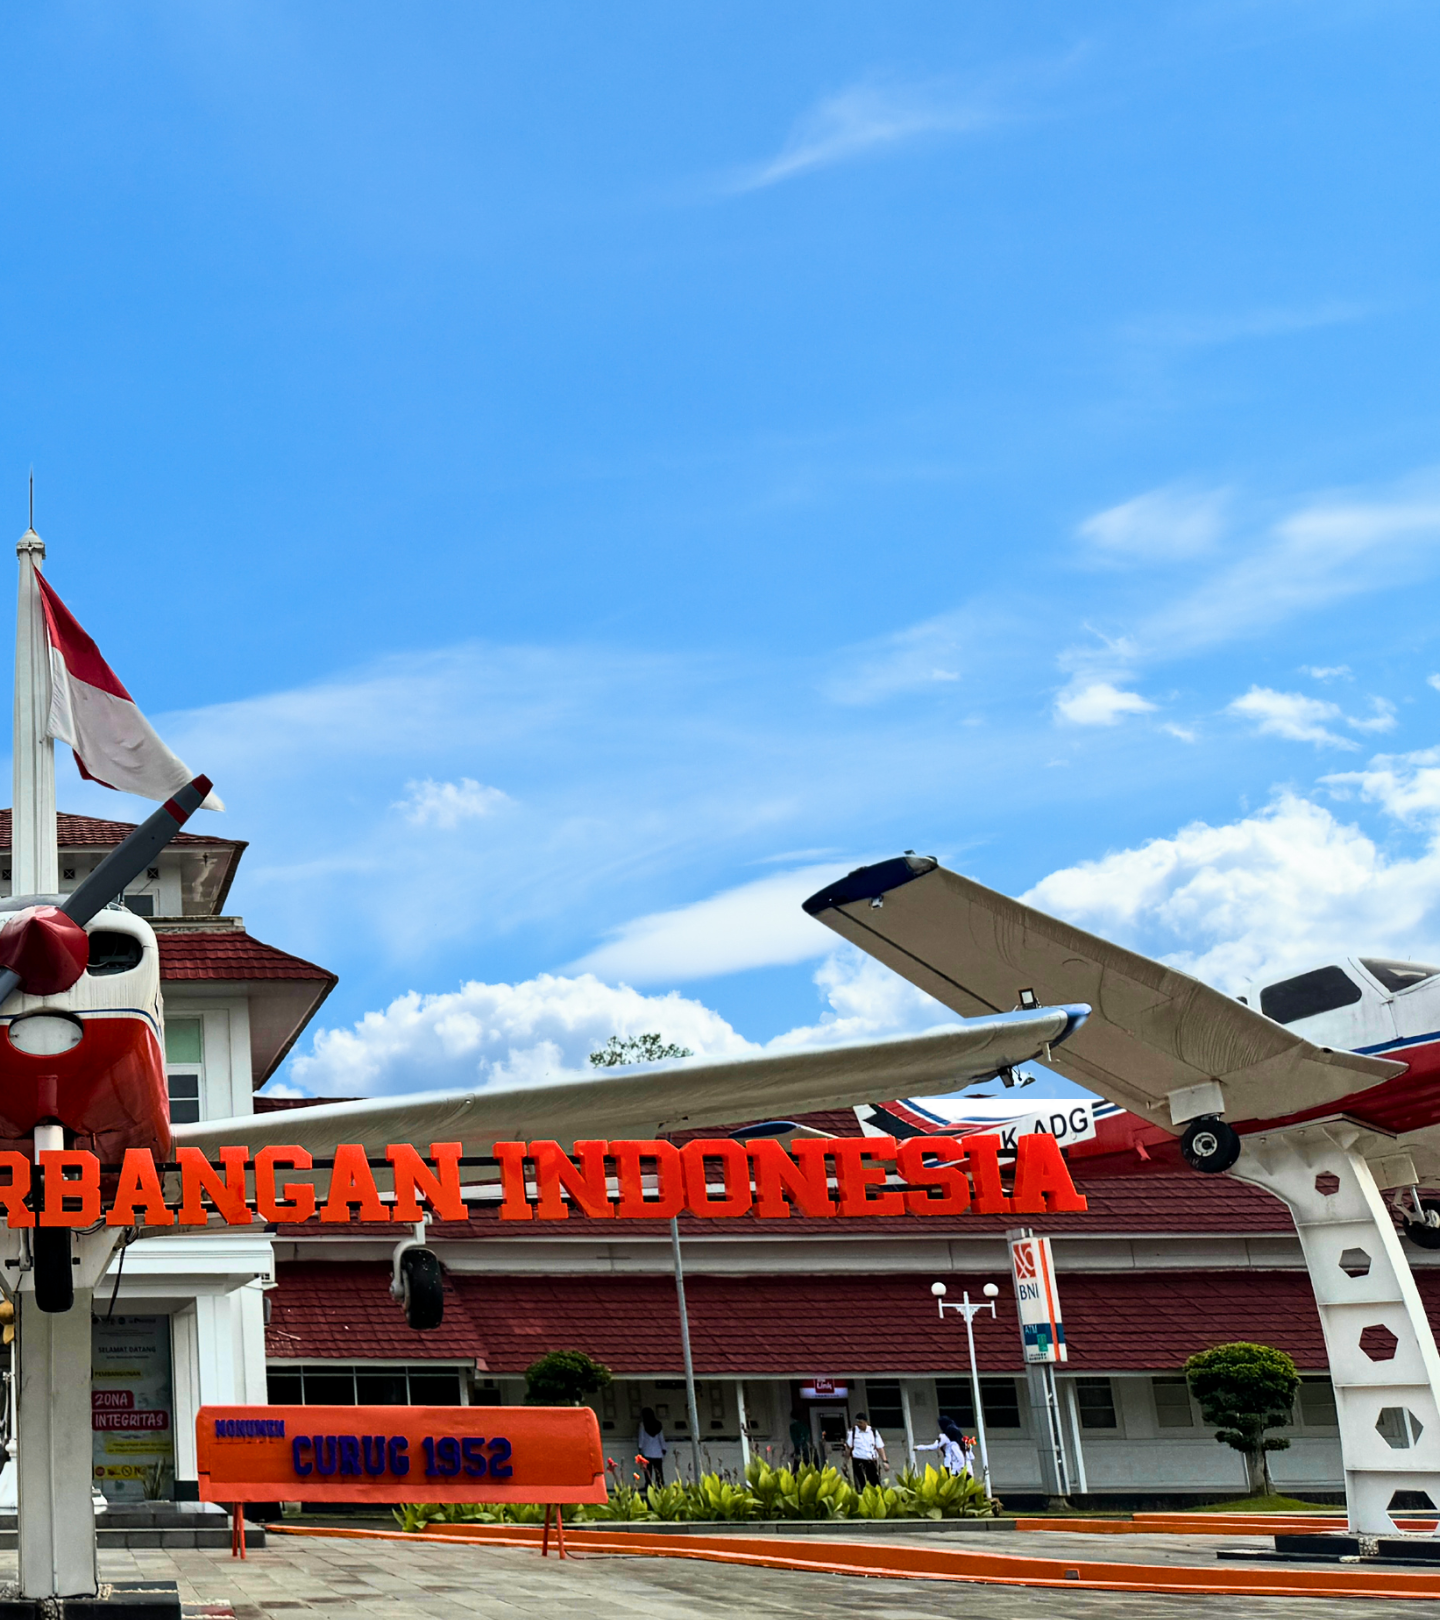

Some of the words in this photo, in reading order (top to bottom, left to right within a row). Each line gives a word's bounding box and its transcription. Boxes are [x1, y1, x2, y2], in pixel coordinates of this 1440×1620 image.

[492, 1133, 1087, 1221] INDONESIA
[1019, 1283, 1039, 1300] BNI
[1024, 1324, 1038, 1334] ATM
[98, 1346, 128, 1354] SELAMAT
[95, 1412, 164, 1427] INTEGRITAS
[292, 1435, 410, 1476] CURUG
[422, 1437, 513, 1477] 1952
